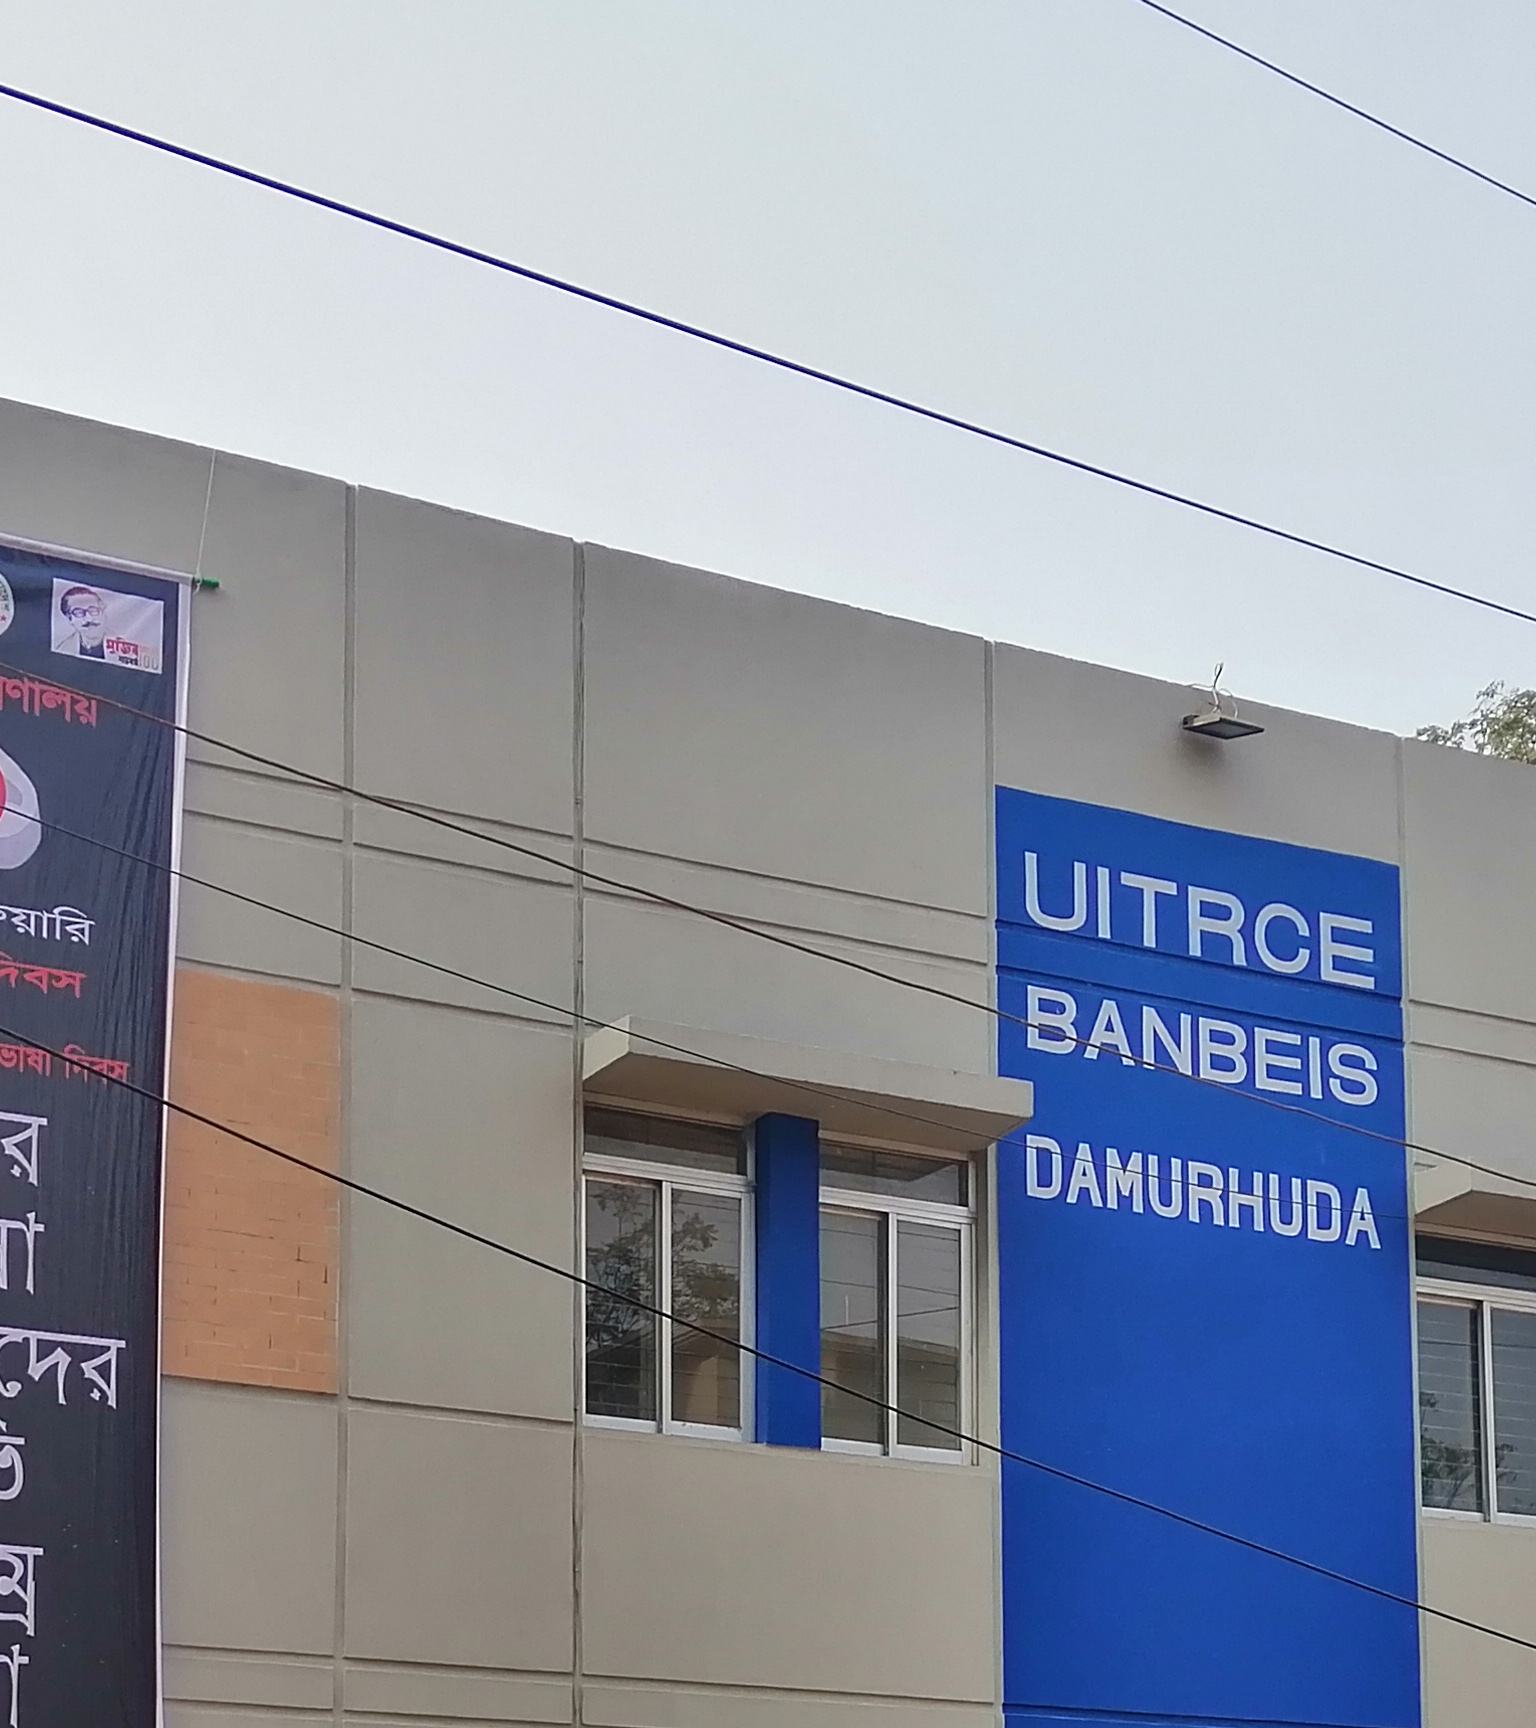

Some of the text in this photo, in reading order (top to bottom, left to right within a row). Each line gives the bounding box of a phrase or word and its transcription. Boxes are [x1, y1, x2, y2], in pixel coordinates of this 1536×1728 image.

[1024, 851, 1375, 990] UITRCE
[1026, 984, 1378, 1106] BANBEIS
[1025, 1133, 1382, 1250] DAMURHUDA
